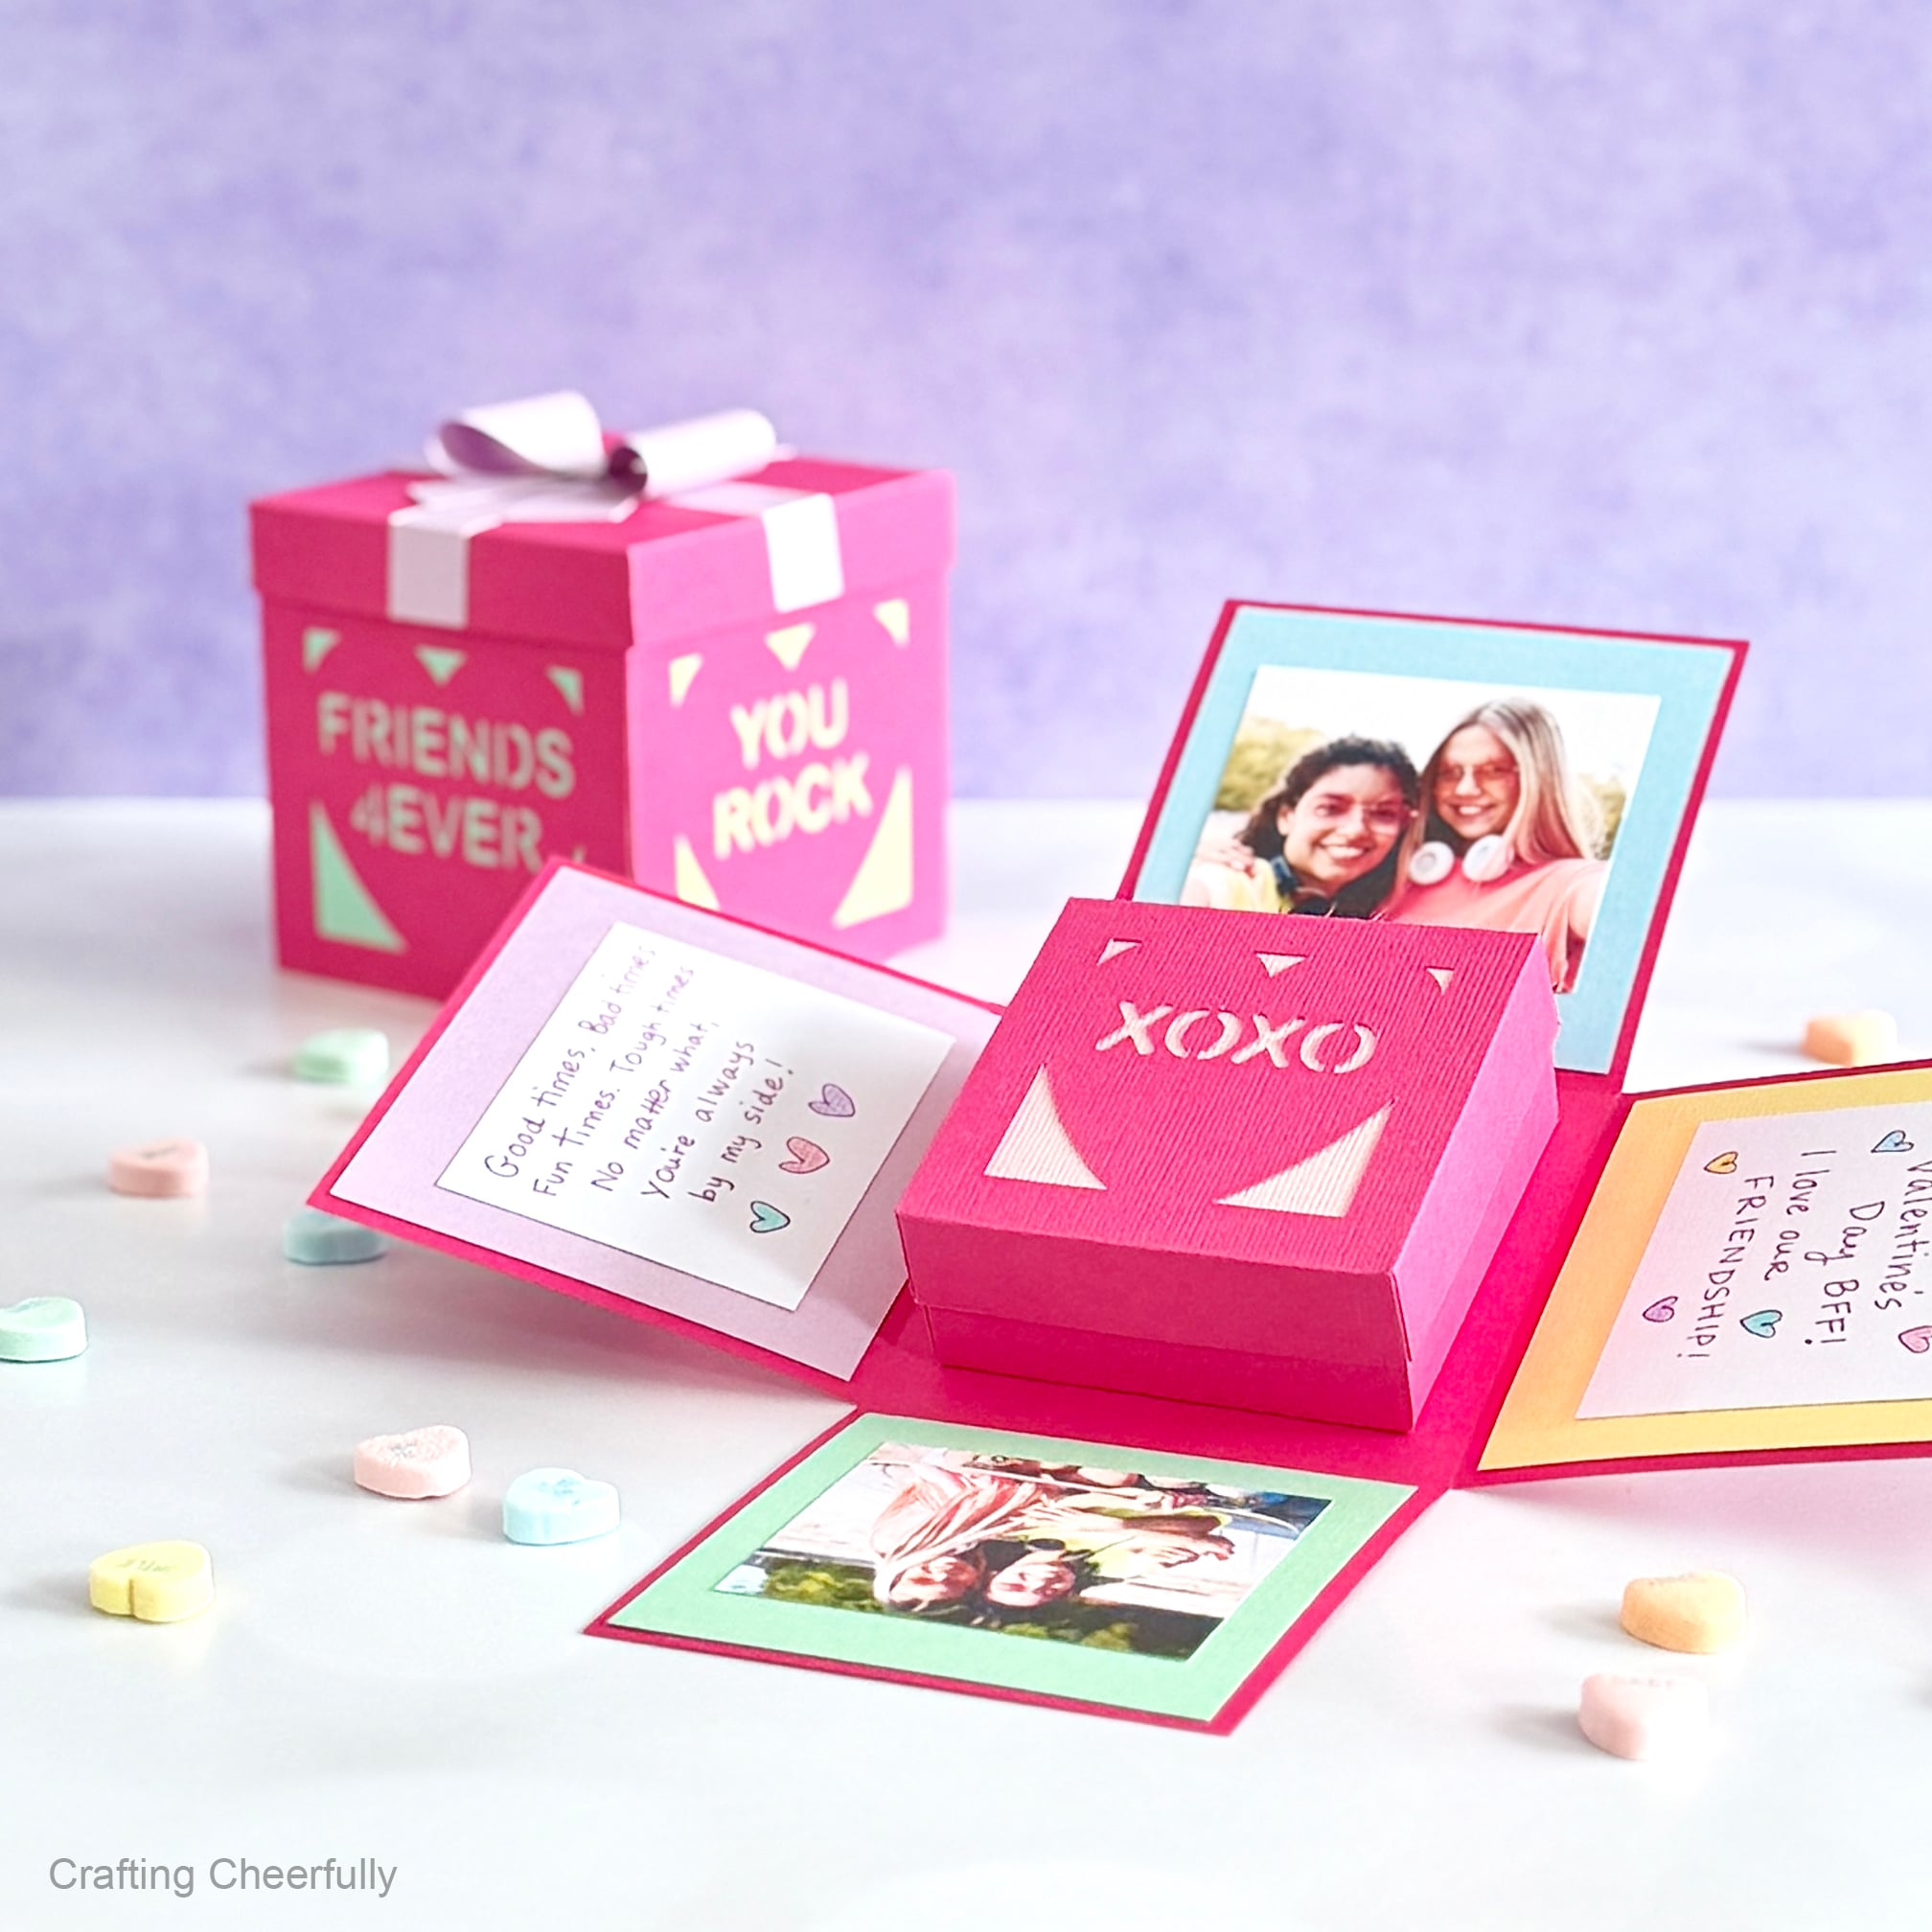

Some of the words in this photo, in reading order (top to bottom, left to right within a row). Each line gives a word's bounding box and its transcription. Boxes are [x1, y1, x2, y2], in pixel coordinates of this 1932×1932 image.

[317, 691, 576, 799] FRIENDS
[731, 676, 849, 770] YOU
[349, 784, 543, 873] 4EVER
[712, 750, 874, 861] ROCK
[484, 1117, 545, 1178] Good
[578, 1000, 622, 1034] Bad
[609, 945, 656, 994] times
[1095, 1000, 1377, 1074] XOXO
[533, 1161, 572, 1196] Fun
[610, 1022, 666, 1072] Tough
[651, 965, 694, 1013] times
[696, 1041, 754, 1122] always
[738, 1058, 794, 1124] side!
[590, 1161, 624, 1192] No
[623, 1079, 672, 1149] matter
[721, 1136, 762, 1162] my
[687, 1176, 735, 1202] by
[1786, 1169, 1830, 1215] love
[1676, 1174, 1774, 1358] FRIENDSHIP!
[1804, 1201, 1885, 1266] Day
[1805, 1278, 1860, 1345] BFF!
